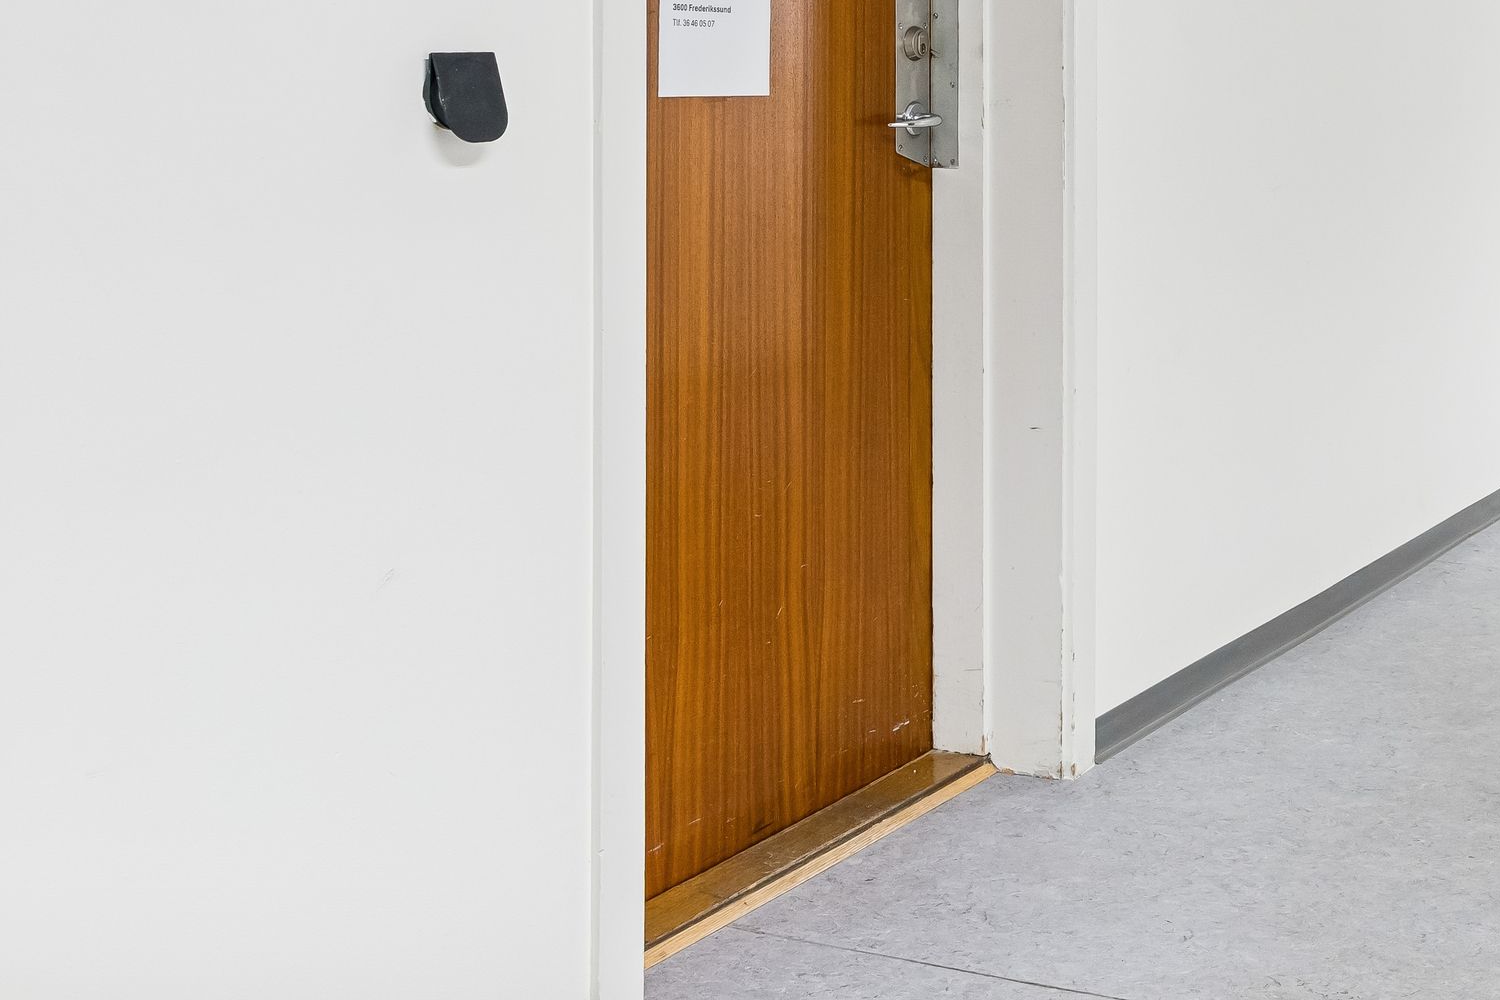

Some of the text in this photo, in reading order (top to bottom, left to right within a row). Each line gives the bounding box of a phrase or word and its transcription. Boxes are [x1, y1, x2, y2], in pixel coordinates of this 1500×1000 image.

[673, 3, 732, 14] 3600 Frederikssund
[673, 18, 682, 27] Tlf.
